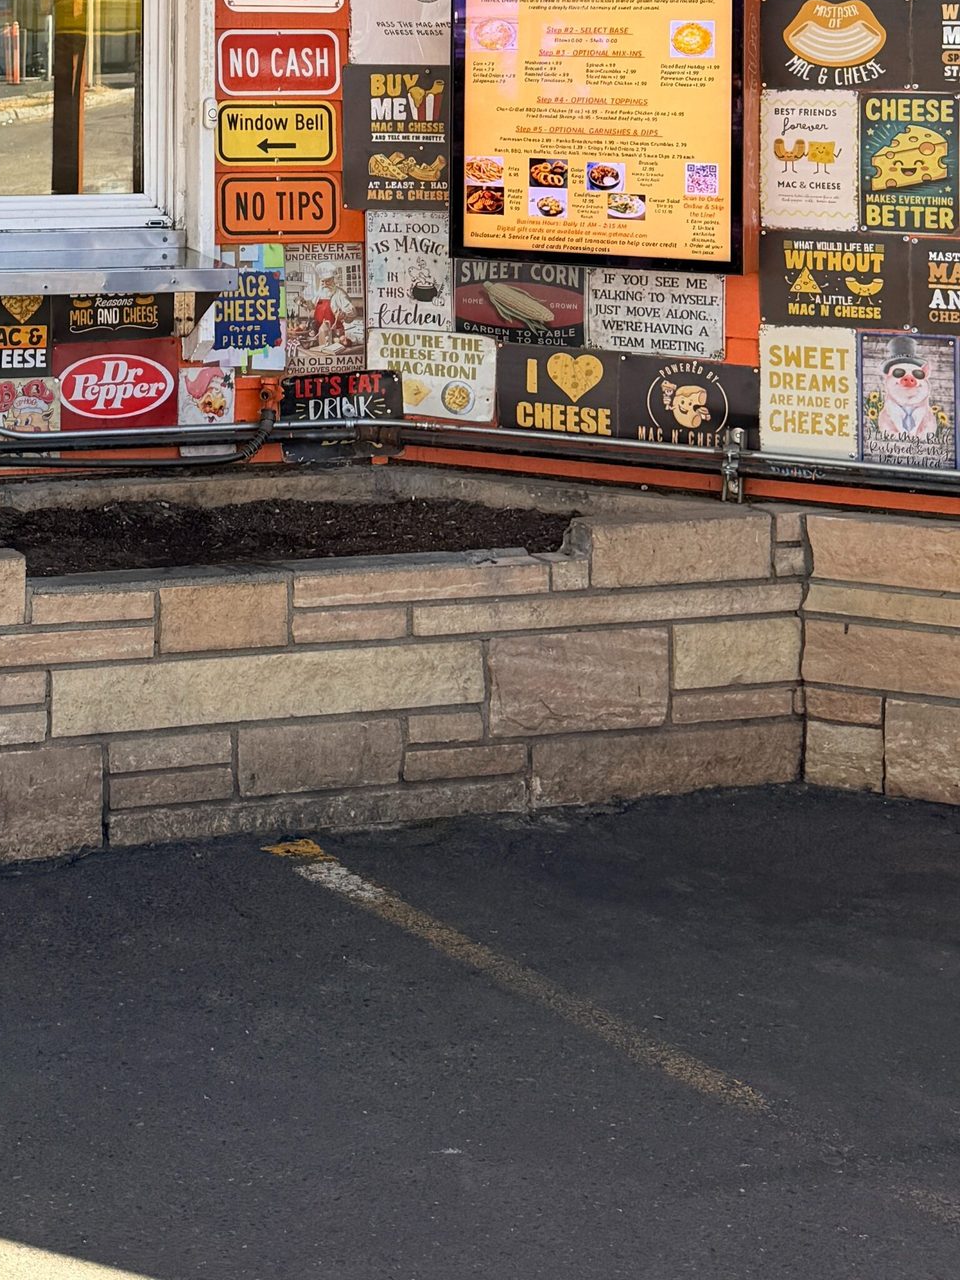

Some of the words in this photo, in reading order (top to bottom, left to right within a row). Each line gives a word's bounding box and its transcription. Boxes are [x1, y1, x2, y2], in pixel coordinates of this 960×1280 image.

[229, 48, 259, 77] NO
[271, 48, 328, 77] CASH
[799, 108, 837, 116] FRIENDS
[866, 98, 954, 122] CHEESE
[227, 114, 287, 130] Window
[296, 114, 323, 130] Bell
[781, 118, 828, 135] forever
[236, 192, 264, 220] NO
[276, 192, 323, 220] TIPS
[866, 194, 896, 203] MAKES
[899, 195, 953, 206] EVERYTHING
[866, 206, 954, 229] BETTER
[379, 223, 402, 233] ALL
[405, 224, 439, 234] FOOD
[302, 244, 344, 252] NEVER
[784, 250, 884, 273] WITHOUT
[460, 262, 522, 283] SWEET
[531, 264, 579, 288] CORN
[604, 274, 614, 284] IF
[620, 274, 648, 286] YOU
[655, 277, 679, 288] SEE
[686, 278, 707, 289] ME
[592, 289, 642, 302] TALKING
[648, 292, 664, 302] TO
[594, 305, 620, 316] JUST
[626, 307, 660, 318] MOVE
[602, 320, 641, 332] WE'RE
[644, 322, 692, 336] HAVING
[699, 327, 708, 336] A
[380, 332, 444, 350] YOU'RE
[451, 336, 484, 352] THE
[611, 335, 644, 347] TEAM
[652, 339, 704, 352] MEETING
[379, 347, 435, 361] CHEESE
[440, 350, 459, 363] TO
[465, 354, 485, 366] MY
[769, 345, 849, 370] SWEET
[99, 360, 143, 384] Dr
[387, 360, 477, 380] MACARONI
[73, 374, 165, 410] Pepper
[296, 375, 341, 398] LET'S
[769, 372, 849, 393] DREAMS
[309, 395, 375, 420] DRINK
[770, 396, 793, 407] ARE
[797, 397, 830, 408] MADE
[835, 398, 849, 409] OF
[517, 402, 611, 436] CHEESE
[770, 410, 850, 437] CHEESE
